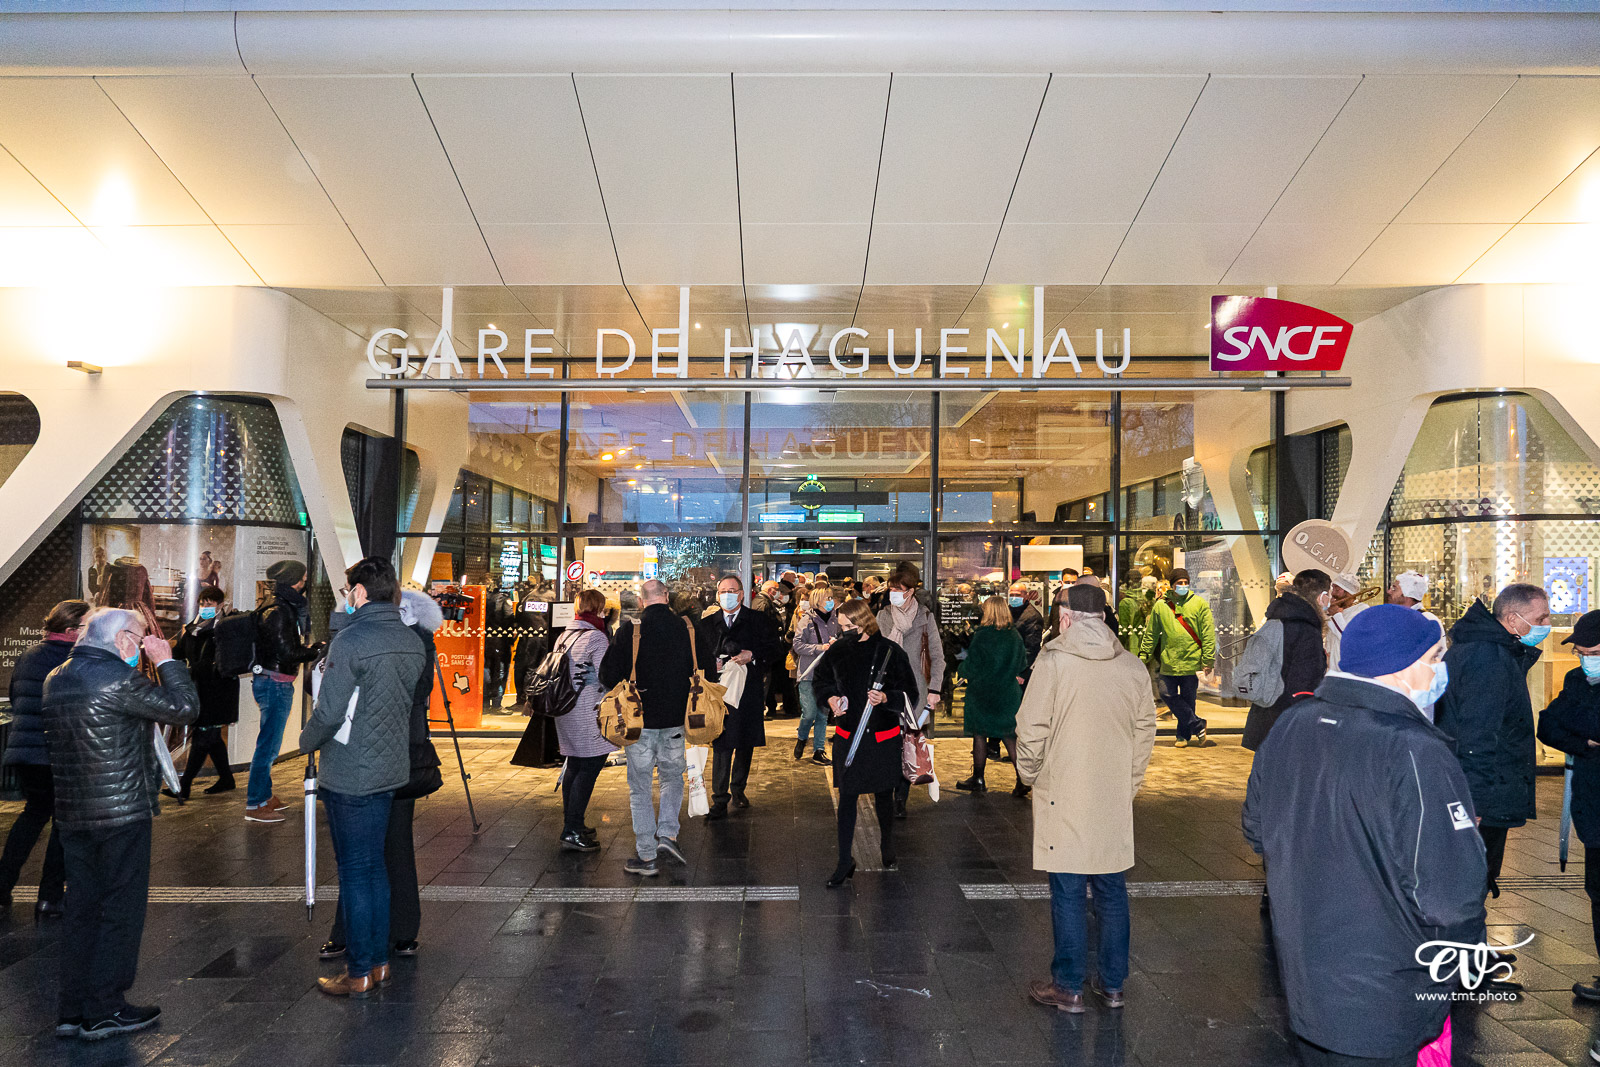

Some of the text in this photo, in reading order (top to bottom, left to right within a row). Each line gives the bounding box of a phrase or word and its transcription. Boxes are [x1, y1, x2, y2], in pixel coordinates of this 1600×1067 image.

[366, 328, 1131, 375] GARE DE HAGUENAU
[1216, 325, 1343, 362] SNCF
[1295, 531, 1340, 570] O.G.M.
[443, 618, 469, 637] ICI
[2, 658, 15, 668] de
